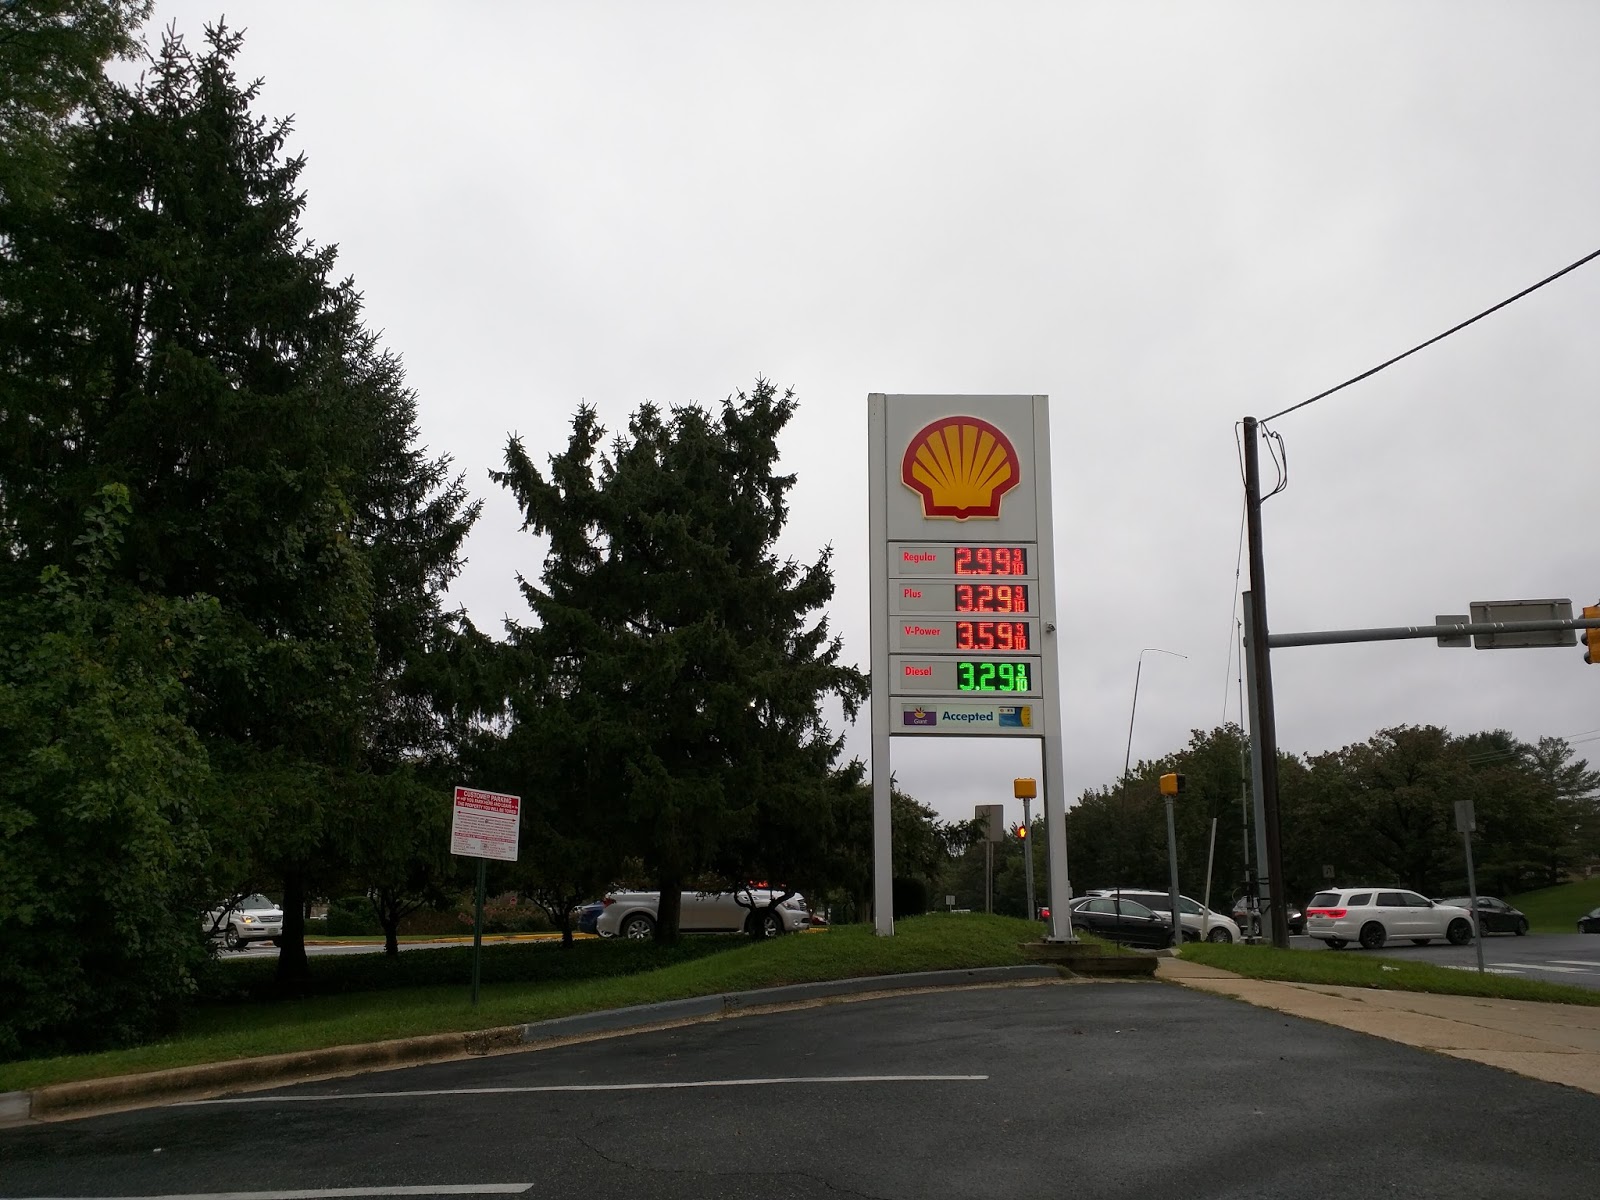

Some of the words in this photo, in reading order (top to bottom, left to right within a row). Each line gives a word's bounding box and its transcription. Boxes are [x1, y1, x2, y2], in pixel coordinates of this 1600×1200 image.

[904, 552, 936, 563] Regular
[904, 588, 921, 598] Plus
[904, 626, 941, 636] V-Power
[905, 666, 932, 676] Diesel
[942, 711, 993, 723] Accepted
[463, 791, 490, 801] CUSTOMER
[491, 795, 512, 804] PARKING
